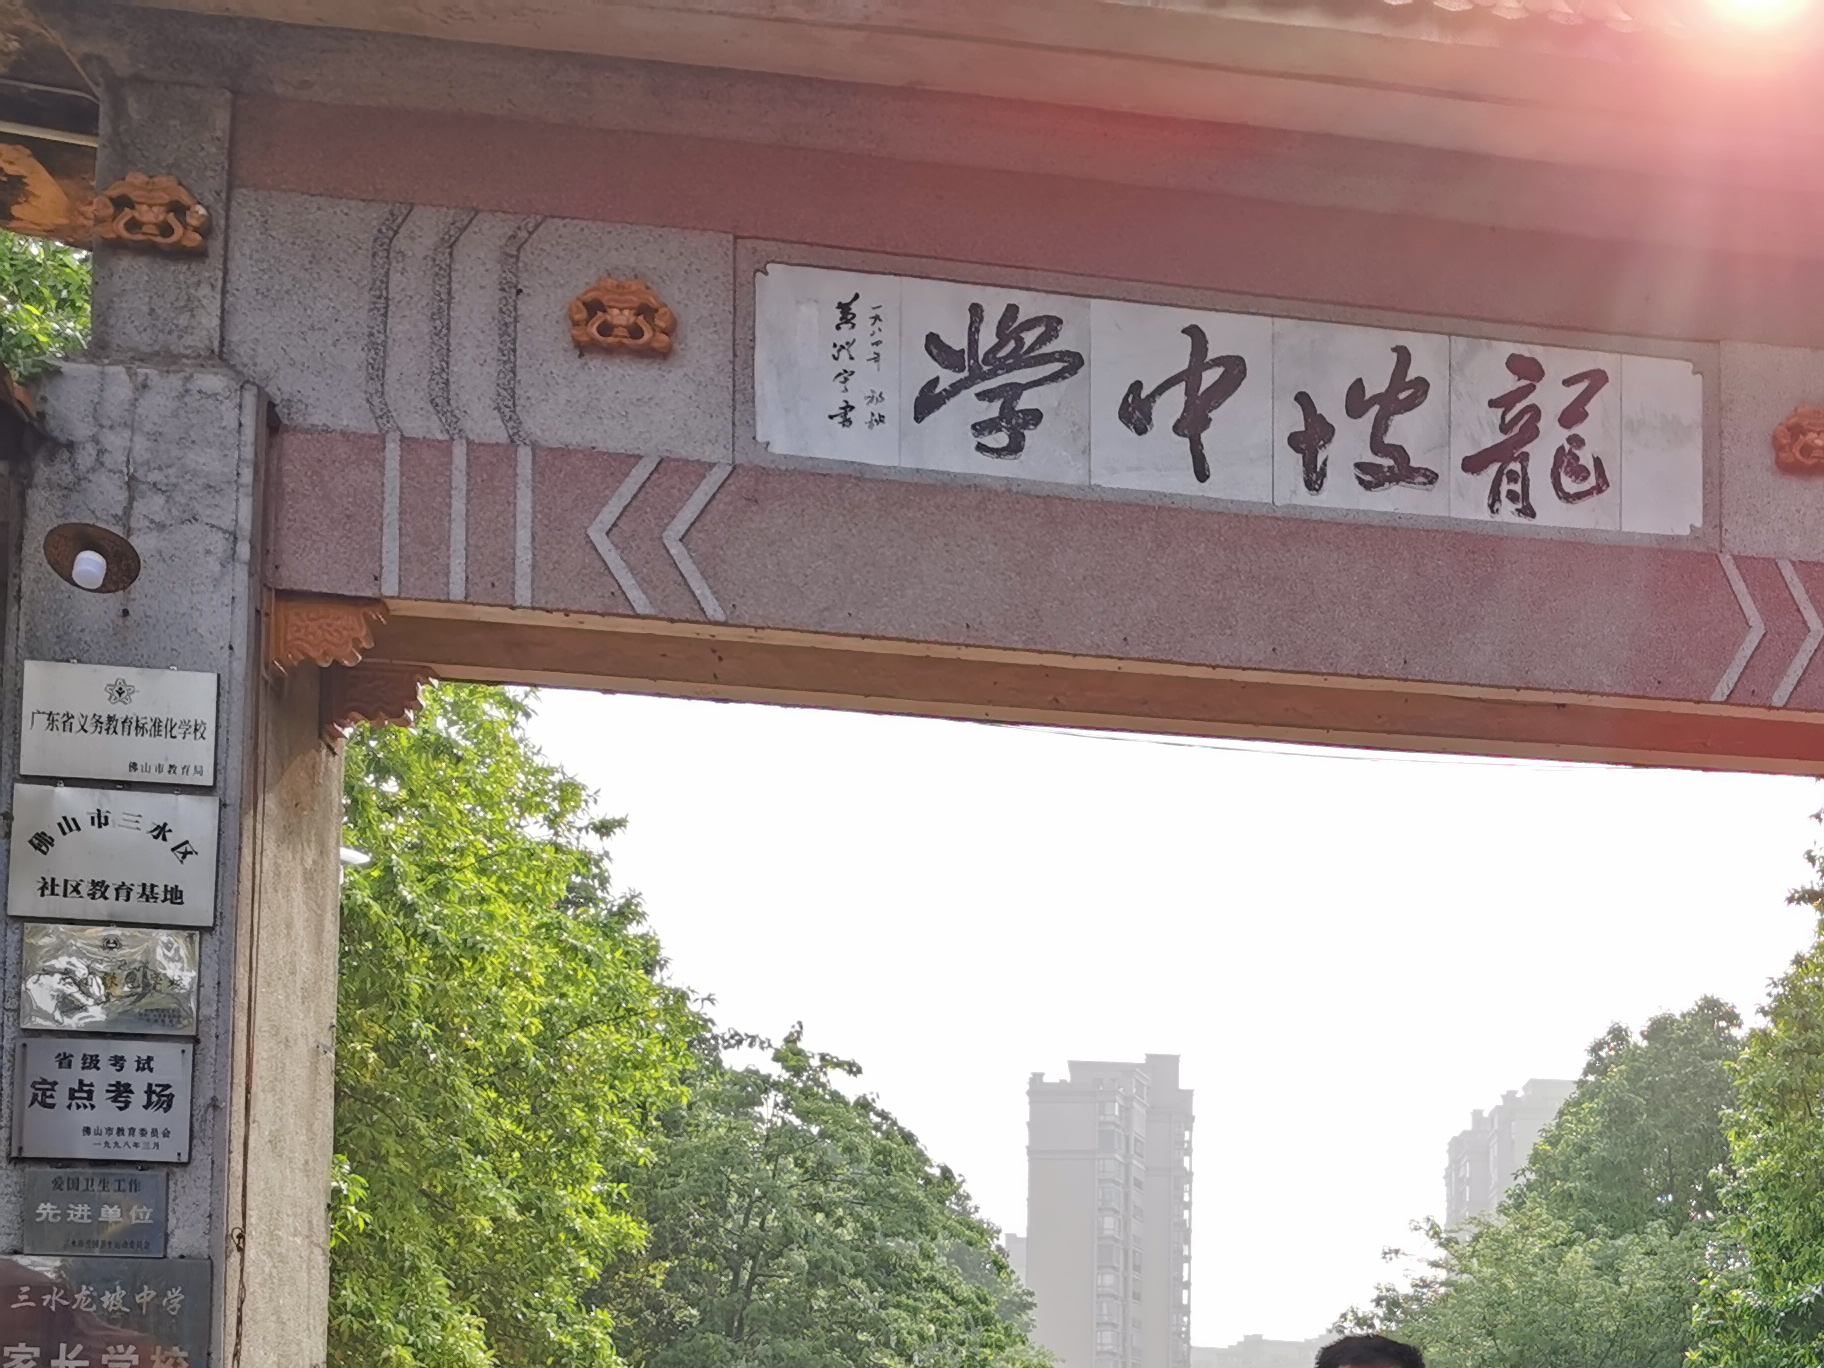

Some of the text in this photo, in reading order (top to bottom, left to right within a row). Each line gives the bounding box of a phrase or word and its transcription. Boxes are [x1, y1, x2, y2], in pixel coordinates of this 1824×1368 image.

[30, 709, 207, 741] 广东省义务教育标准化学校
[128, 761, 205, 777] 佛山市教育局
[27, 808, 199, 865] 佛山市三水区
[36, 876, 186, 906] 社区教育基地
[54, 1052, 155, 1074] 省级考试
[28, 1077, 176, 1114] 定点考场
[35, 1202, 154, 1225] 先进单位
[11, 1284, 186, 1316] 三水龙坡中学
